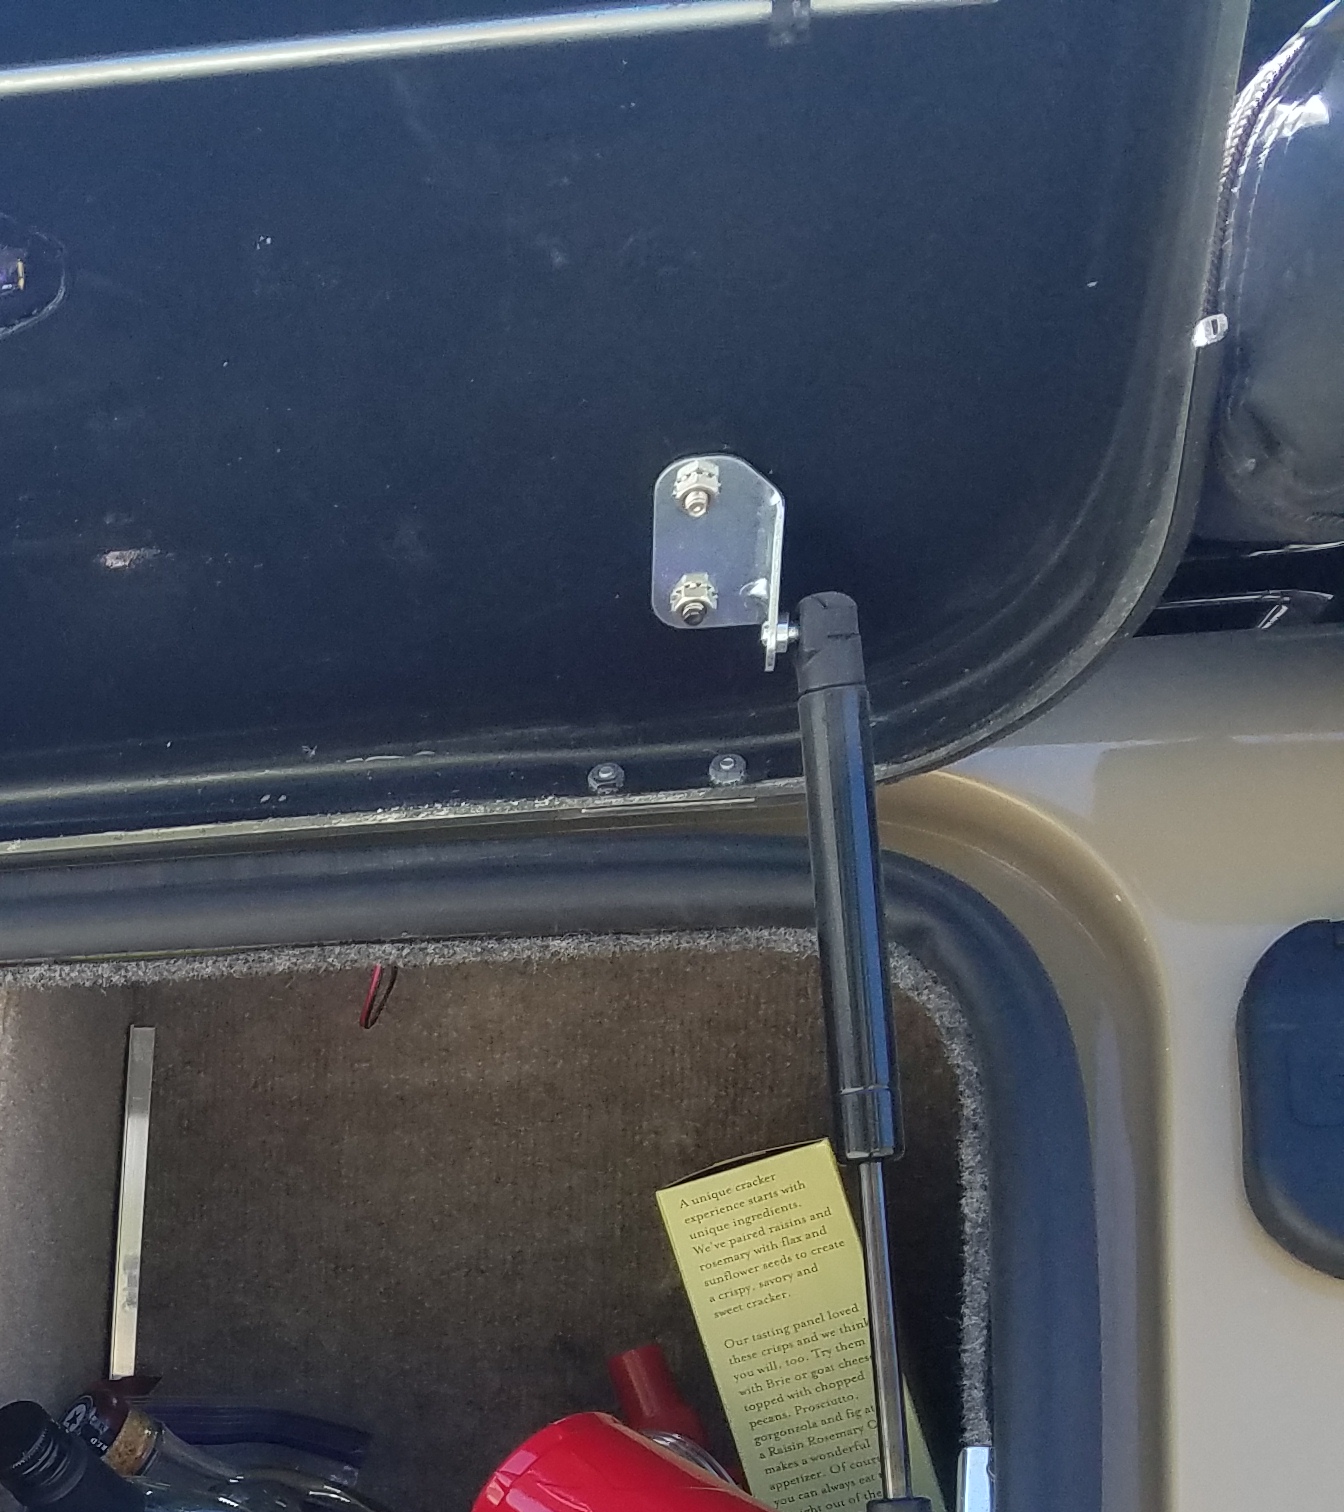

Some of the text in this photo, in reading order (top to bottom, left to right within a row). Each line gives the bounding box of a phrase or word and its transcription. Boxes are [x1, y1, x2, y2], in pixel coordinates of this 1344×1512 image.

[680, 1173, 776, 1209] A unique cracker
[684, 1181, 806, 1224] experience starts with
[690, 1202, 802, 1240] unique ingredients.
[693, 1207, 832, 1255] We've paired raisins and
[700, 1225, 827, 1271] rosemary with flax and
[704, 1240, 845, 1287] sunflower seeds to create
[759, 1273, 793, 1288] savory
[797, 1263, 819, 1277] and
[714, 1290, 791, 1319] sweet cracker.
[724, 1303, 859, 1349] Our tasting panel loved
[729, 1351, 757, 1365] these
[762, 1341, 793, 1356] crisps
[797, 1332, 819, 1346] and
[822, 1330, 836, 1339] we
[734, 1370, 754, 1383] you
[786, 1356, 809, 1367] too.
[811, 1348, 832, 1359] Try
[835, 1339, 865, 1353] them
[739, 1355, 872, 1396] with Brie or goat chees
[744, 1371, 865, 1412] topped with chopped
[754, 1404, 875, 1446] gorgonzola and fig at
[768, 1442, 804, 1457] Raisin
[808, 1426, 864, 1446] Rosemary
[765, 1460, 799, 1475] makes
[810, 1439, 871, 1461] wonderful
[770, 1456, 880, 1492] appetizer. Of cour
[774, 1496, 795, 1509] you
[799, 1489, 818, 1500] can
[821, 1479, 856, 1494] always
[859, 1474, 876, 1485] eat
[826, 1499, 846, 1510] out
[849, 1493, 861, 1504] of
[864, 1489, 882, 1501] the
